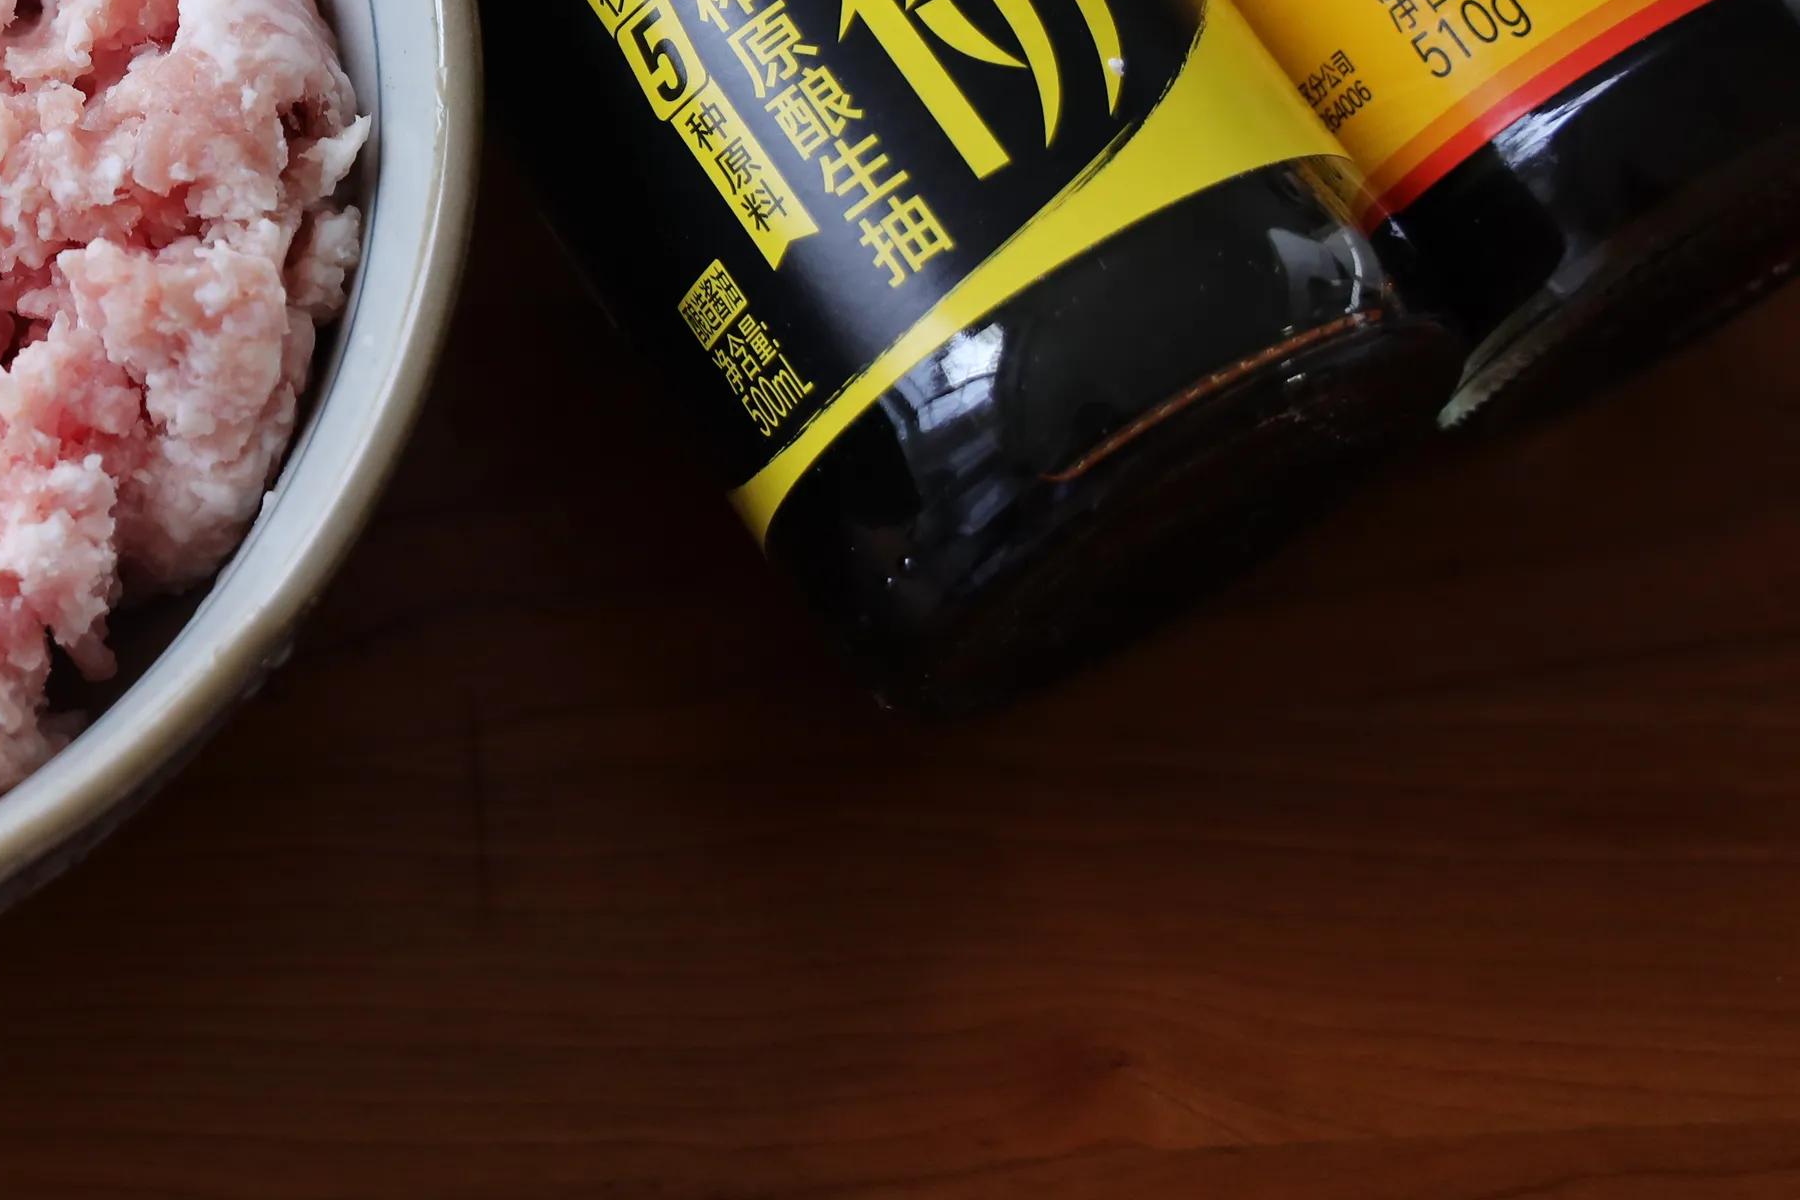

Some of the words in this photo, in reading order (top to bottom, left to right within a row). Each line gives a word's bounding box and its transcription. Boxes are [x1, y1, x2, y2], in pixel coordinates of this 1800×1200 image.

[682, 265, 744, 346] 酿造酱油
[742, 353, 814, 437] 500mL
